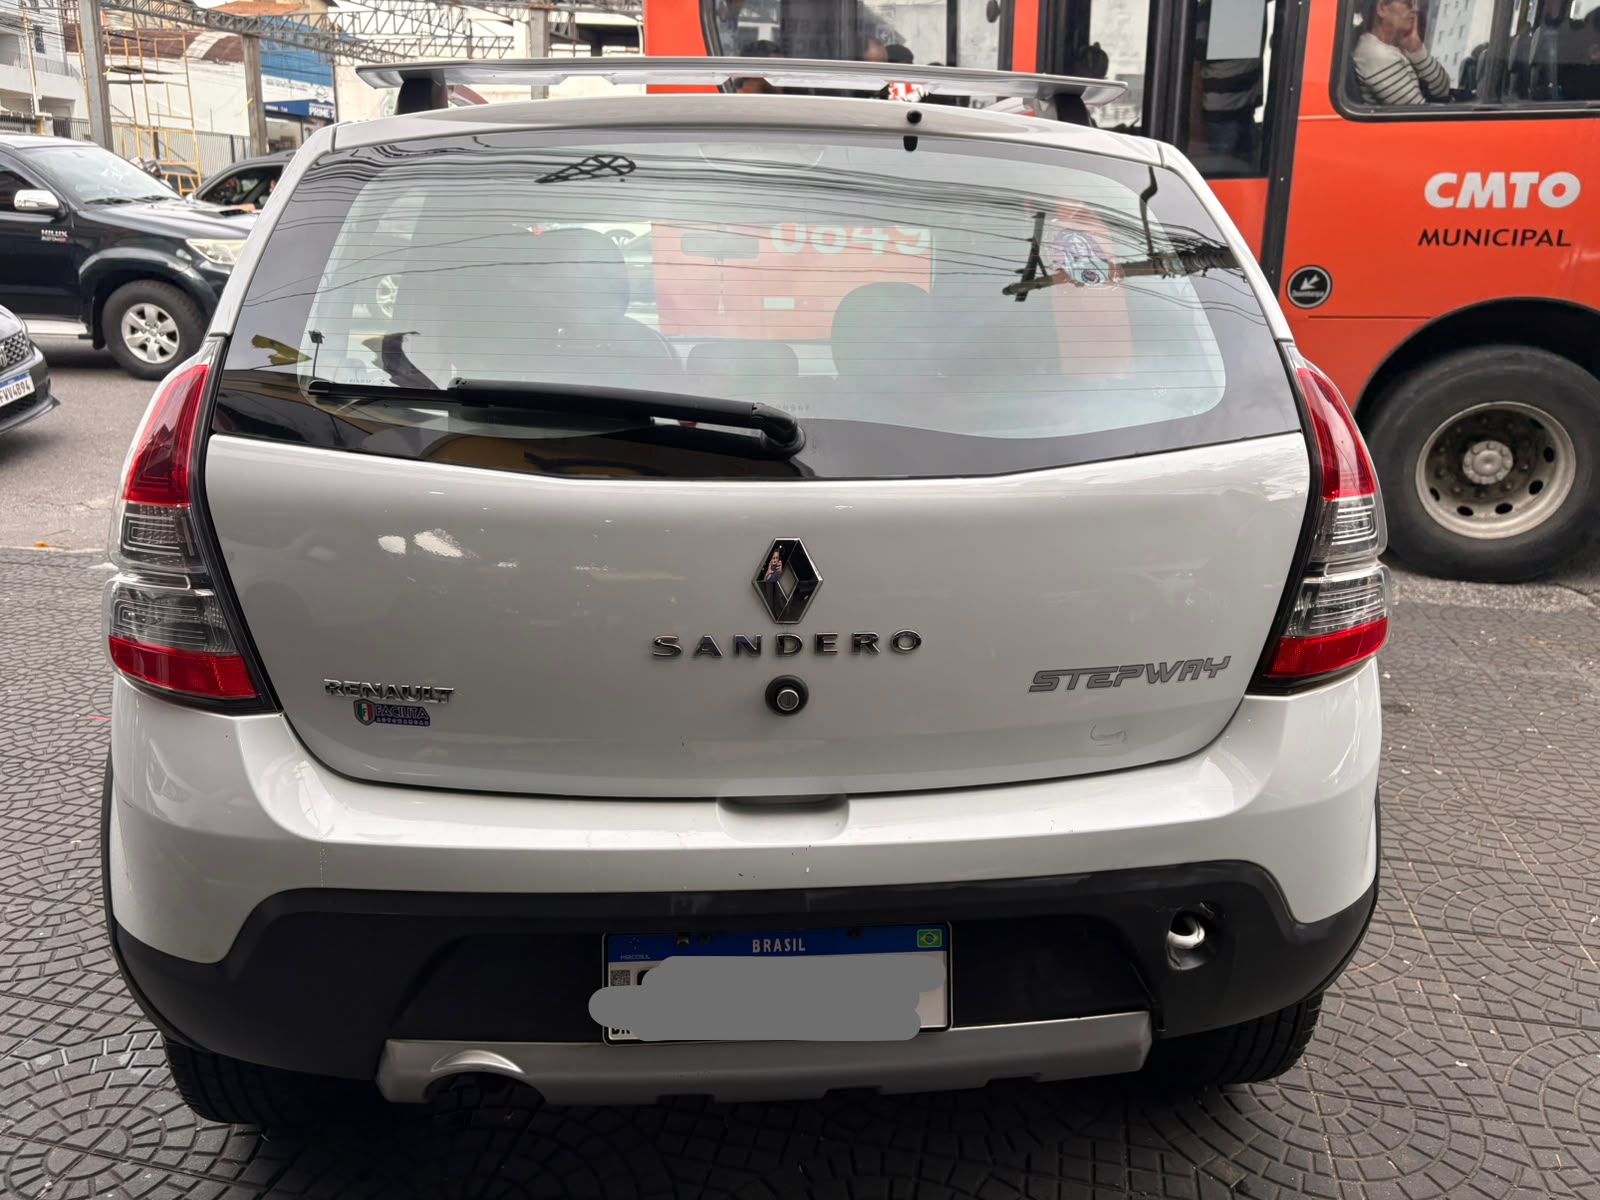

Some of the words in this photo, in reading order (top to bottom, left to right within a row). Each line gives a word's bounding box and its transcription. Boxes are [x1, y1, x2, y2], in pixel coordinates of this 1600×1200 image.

[1424, 172, 1581, 209] CMTO
[41, 229, 68, 237] HILUX
[1418, 228, 1572, 247] MUNICIPAL
[653, 629, 922, 657] SANDERO
[1029, 656, 1231, 692] STEPWAY
[324, 678, 455, 703] RENAULT
[375, 704, 430, 719] FACILITA
[752, 938, 806, 953] BRASIL
